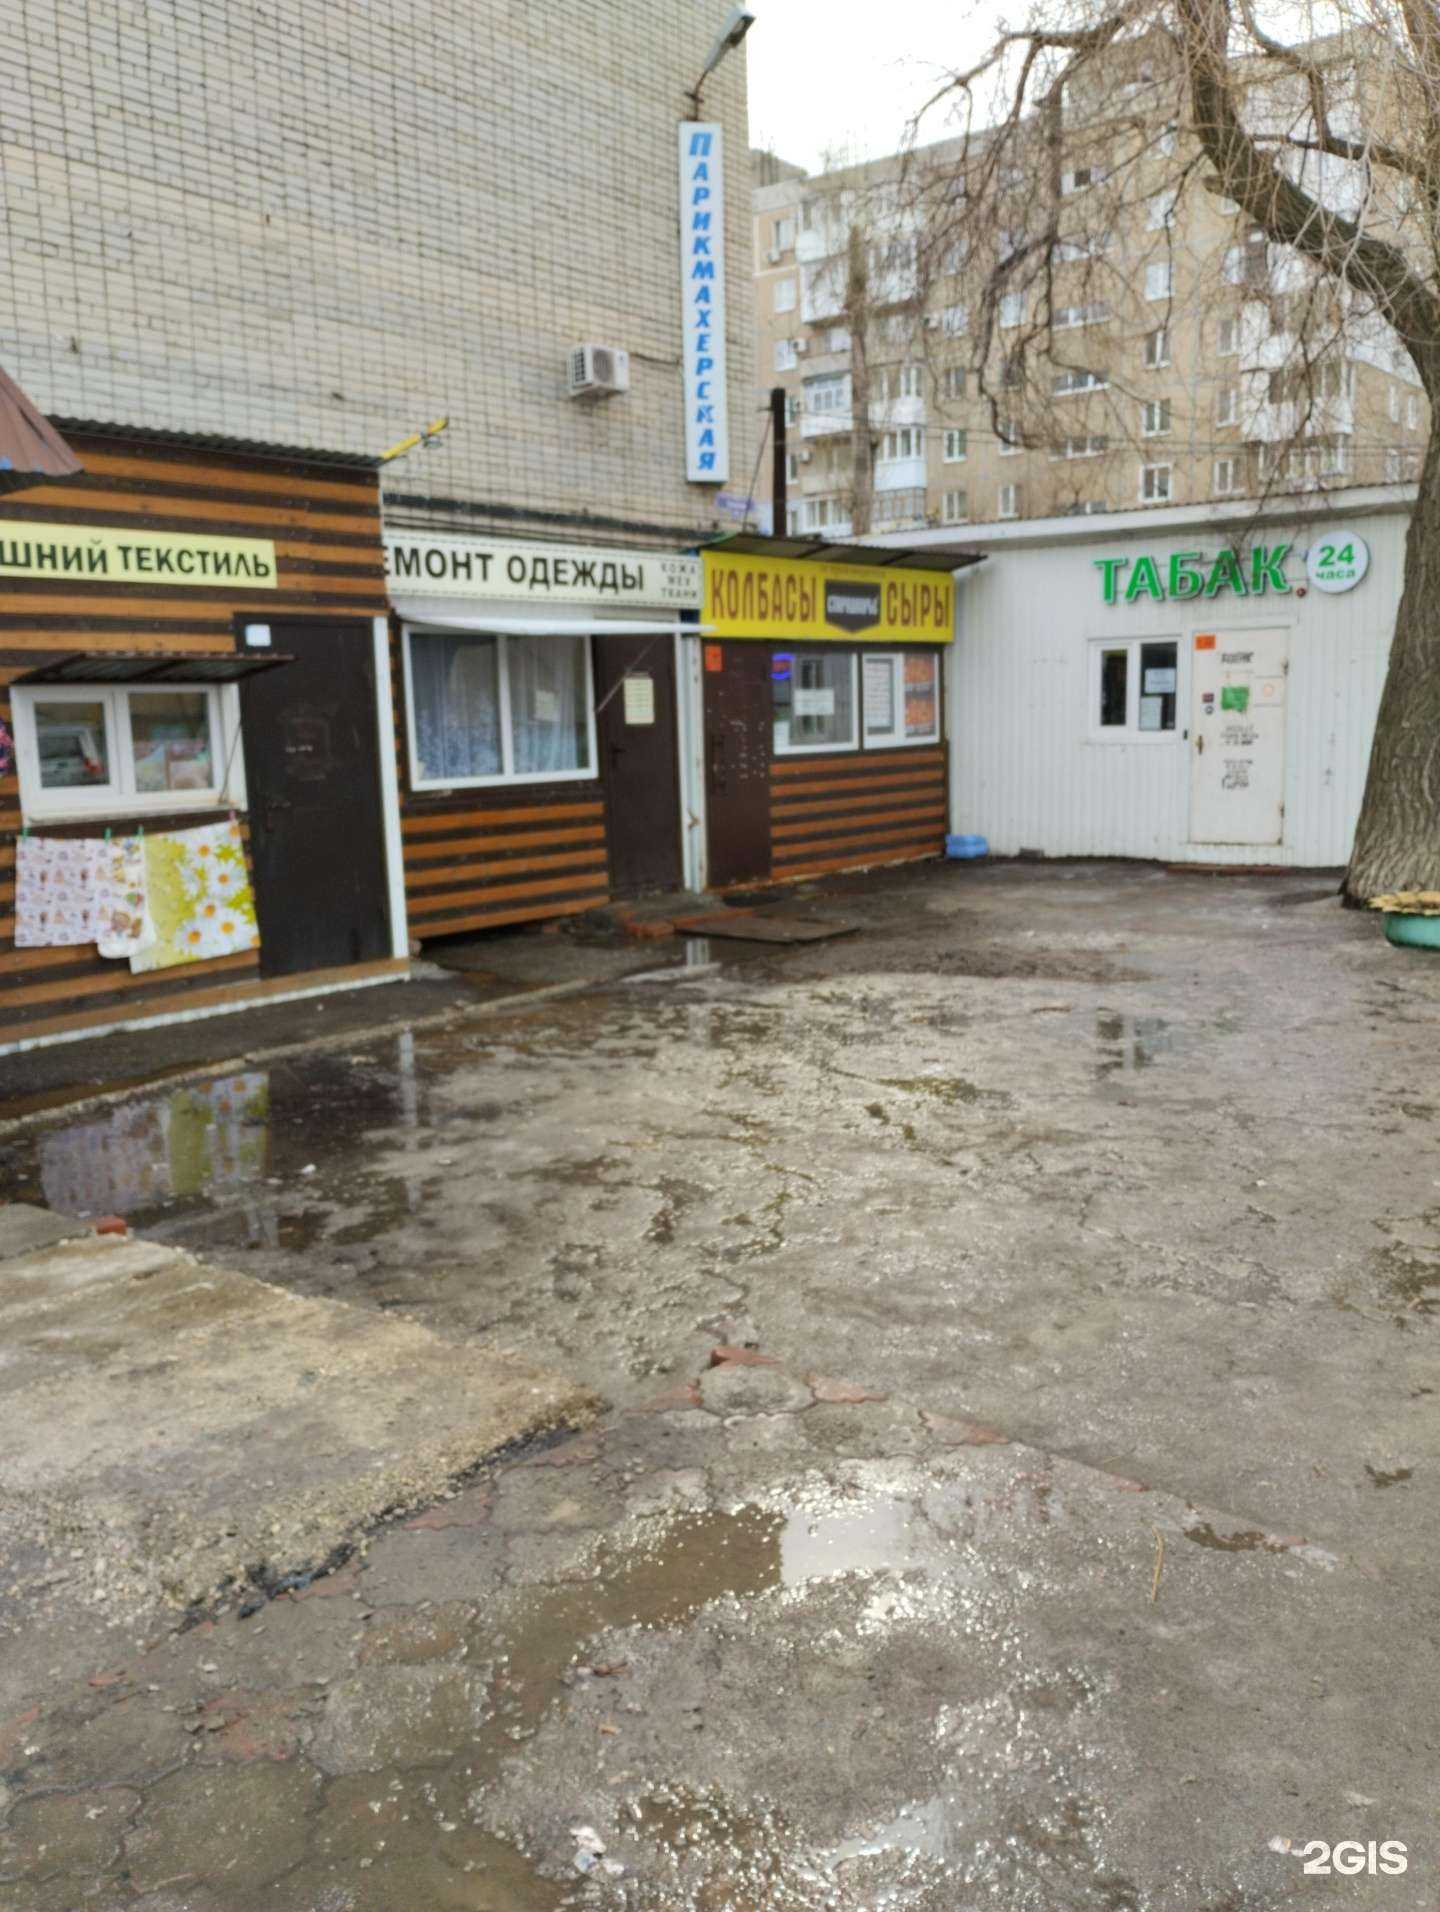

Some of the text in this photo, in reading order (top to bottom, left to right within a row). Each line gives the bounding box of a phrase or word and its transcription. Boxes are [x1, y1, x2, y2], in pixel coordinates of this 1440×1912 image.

[689, 131, 716, 472] ПАРИКМАХЕРСКАЯ
[0, 538, 270, 578] ШНИЙ ТЕКСТИЛЬ
[384, 545, 644, 594] МОНТ ОДЕЖДЫ
[1094, 543, 1292, 604] ТАБАК
[1318, 543, 1355, 567] 24
[711, 569, 950, 628] КОЛБАСЫ СЫРЫ
